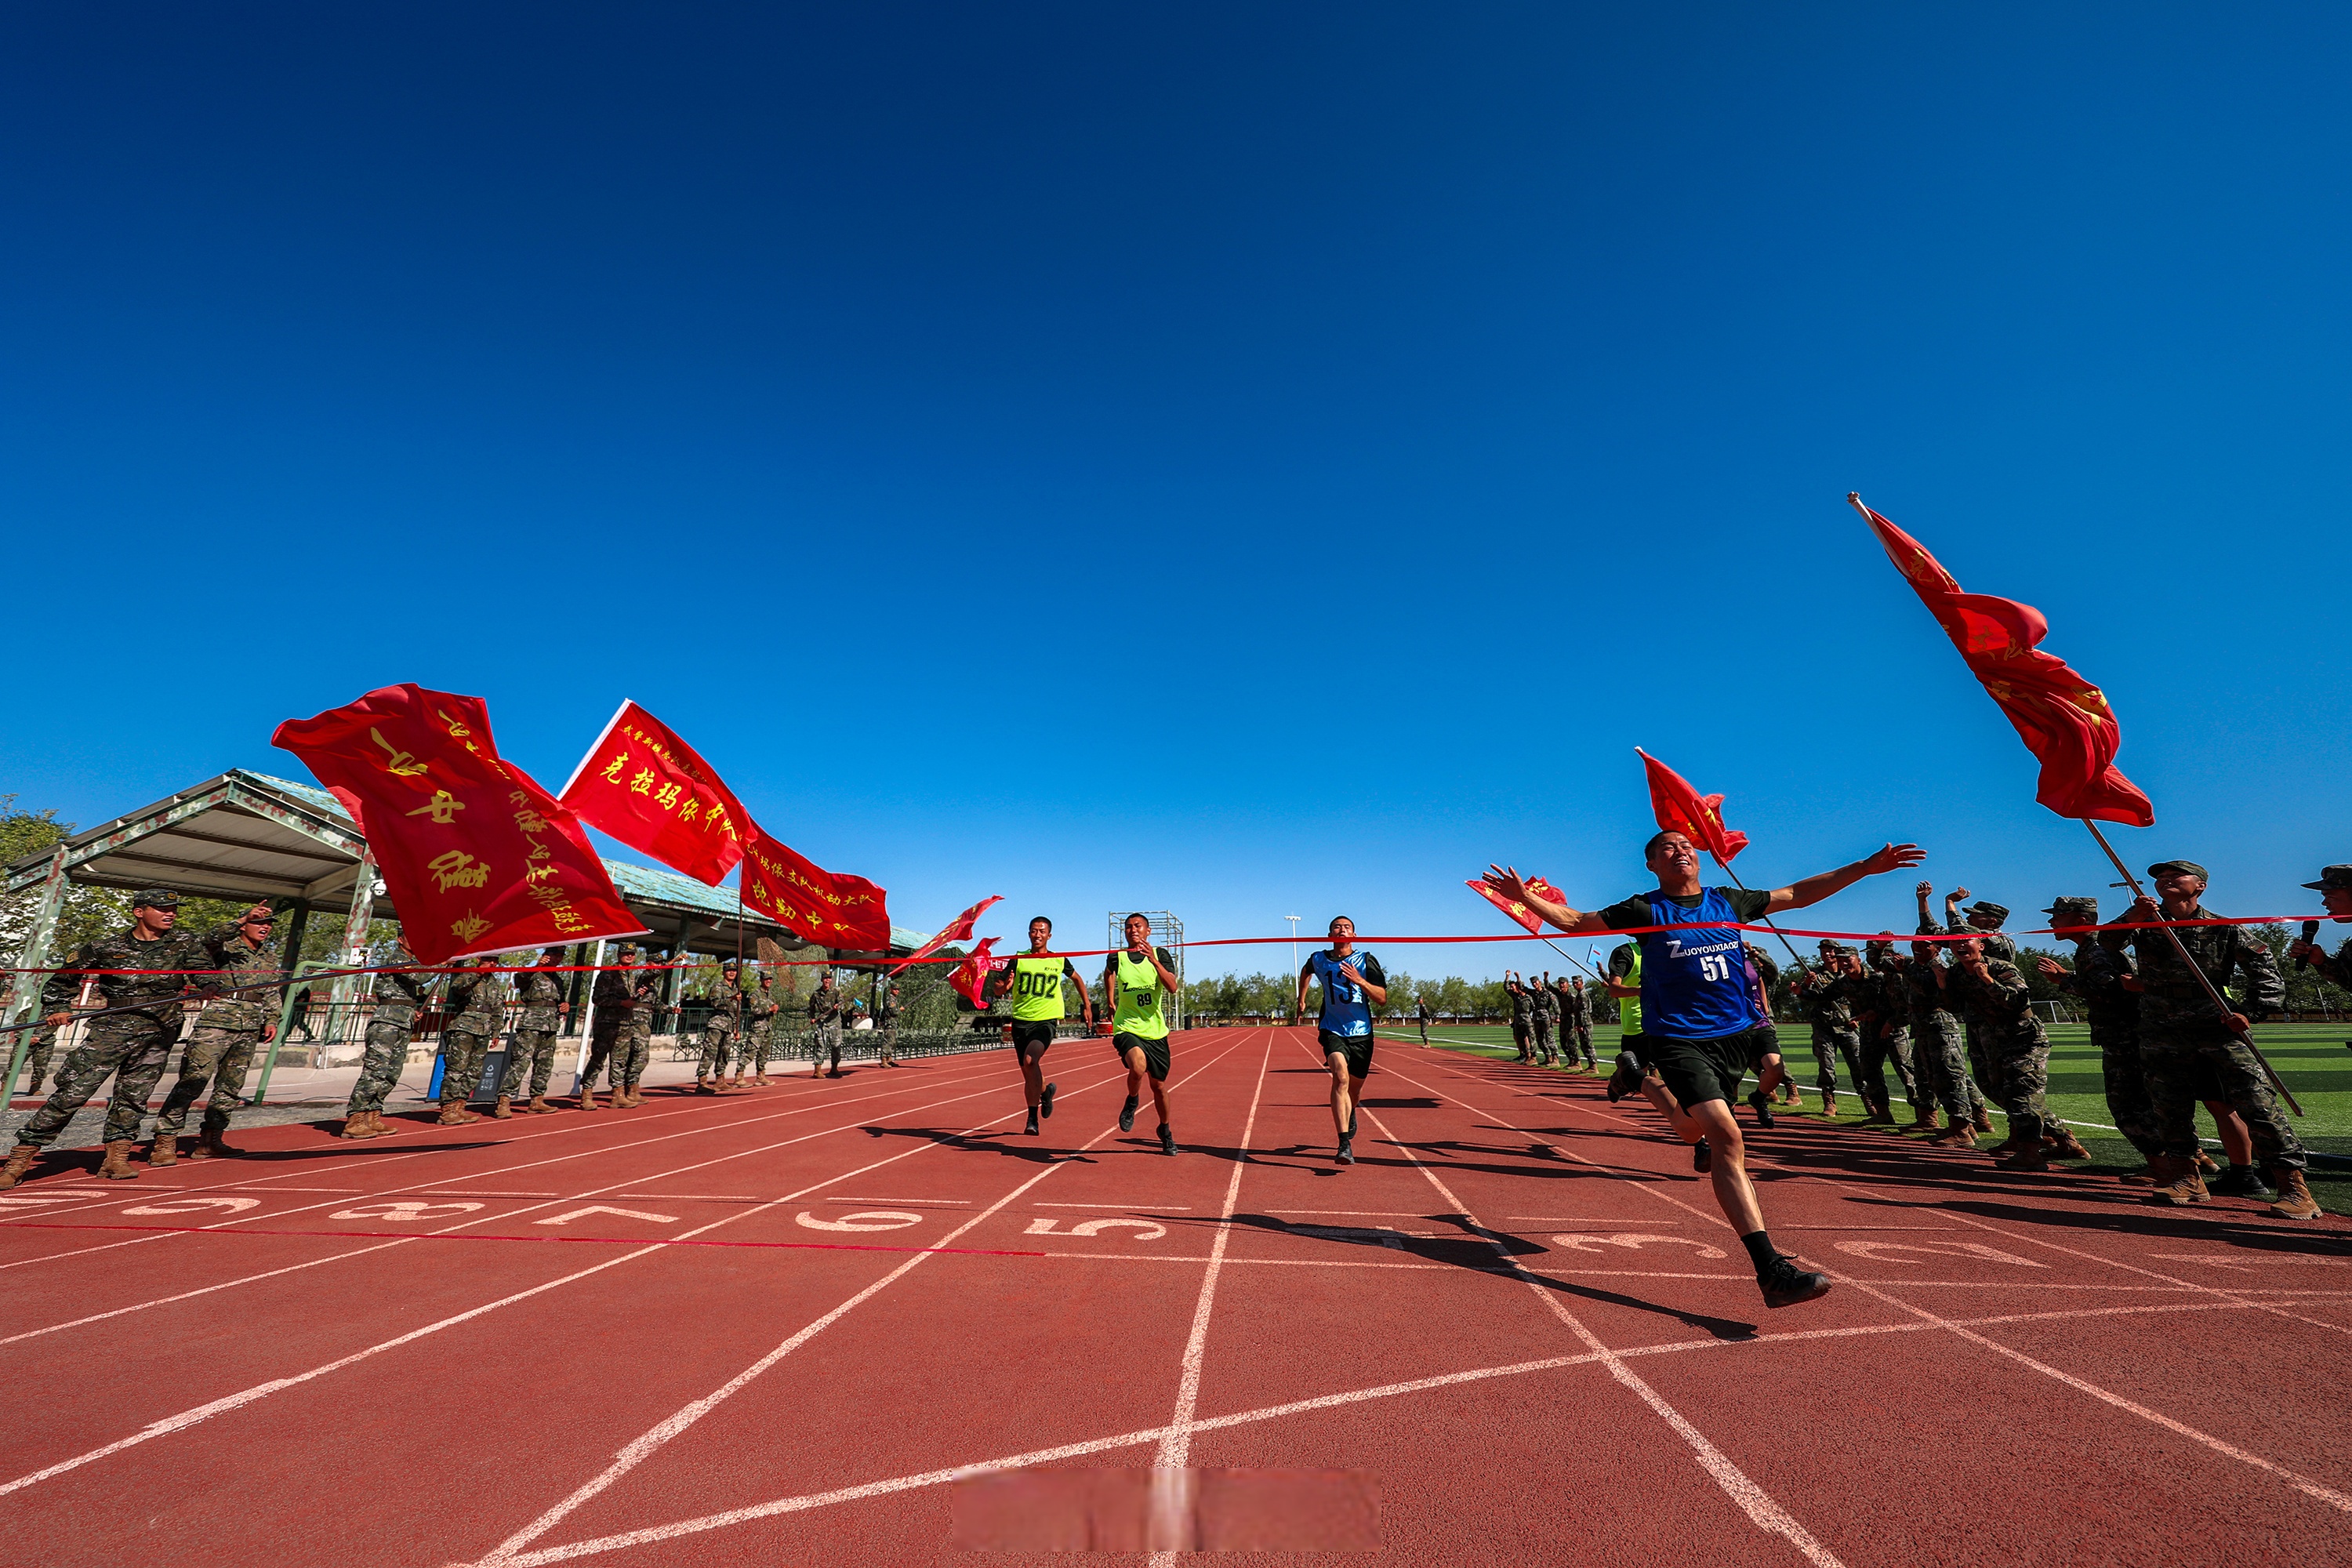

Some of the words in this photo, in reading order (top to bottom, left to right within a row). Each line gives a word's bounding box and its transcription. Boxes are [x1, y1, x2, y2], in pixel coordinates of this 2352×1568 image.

[599, 751, 738, 842] 克拉玛依中队
[1700, 954, 1730, 982] 51
[1018, 972, 1058, 998] 002
[1324, 971, 1353, 1005] 13
[1137, 993, 1152, 1007] 89
[328, 1202, 485, 1221] 8
[532, 1206, 681, 1225] 7
[795, 1211, 922, 1232] 6
[1024, 1218, 1167, 1240] 5
[1552, 1234, 1727, 1258] 3
[1833, 1240, 2053, 1269] 2
